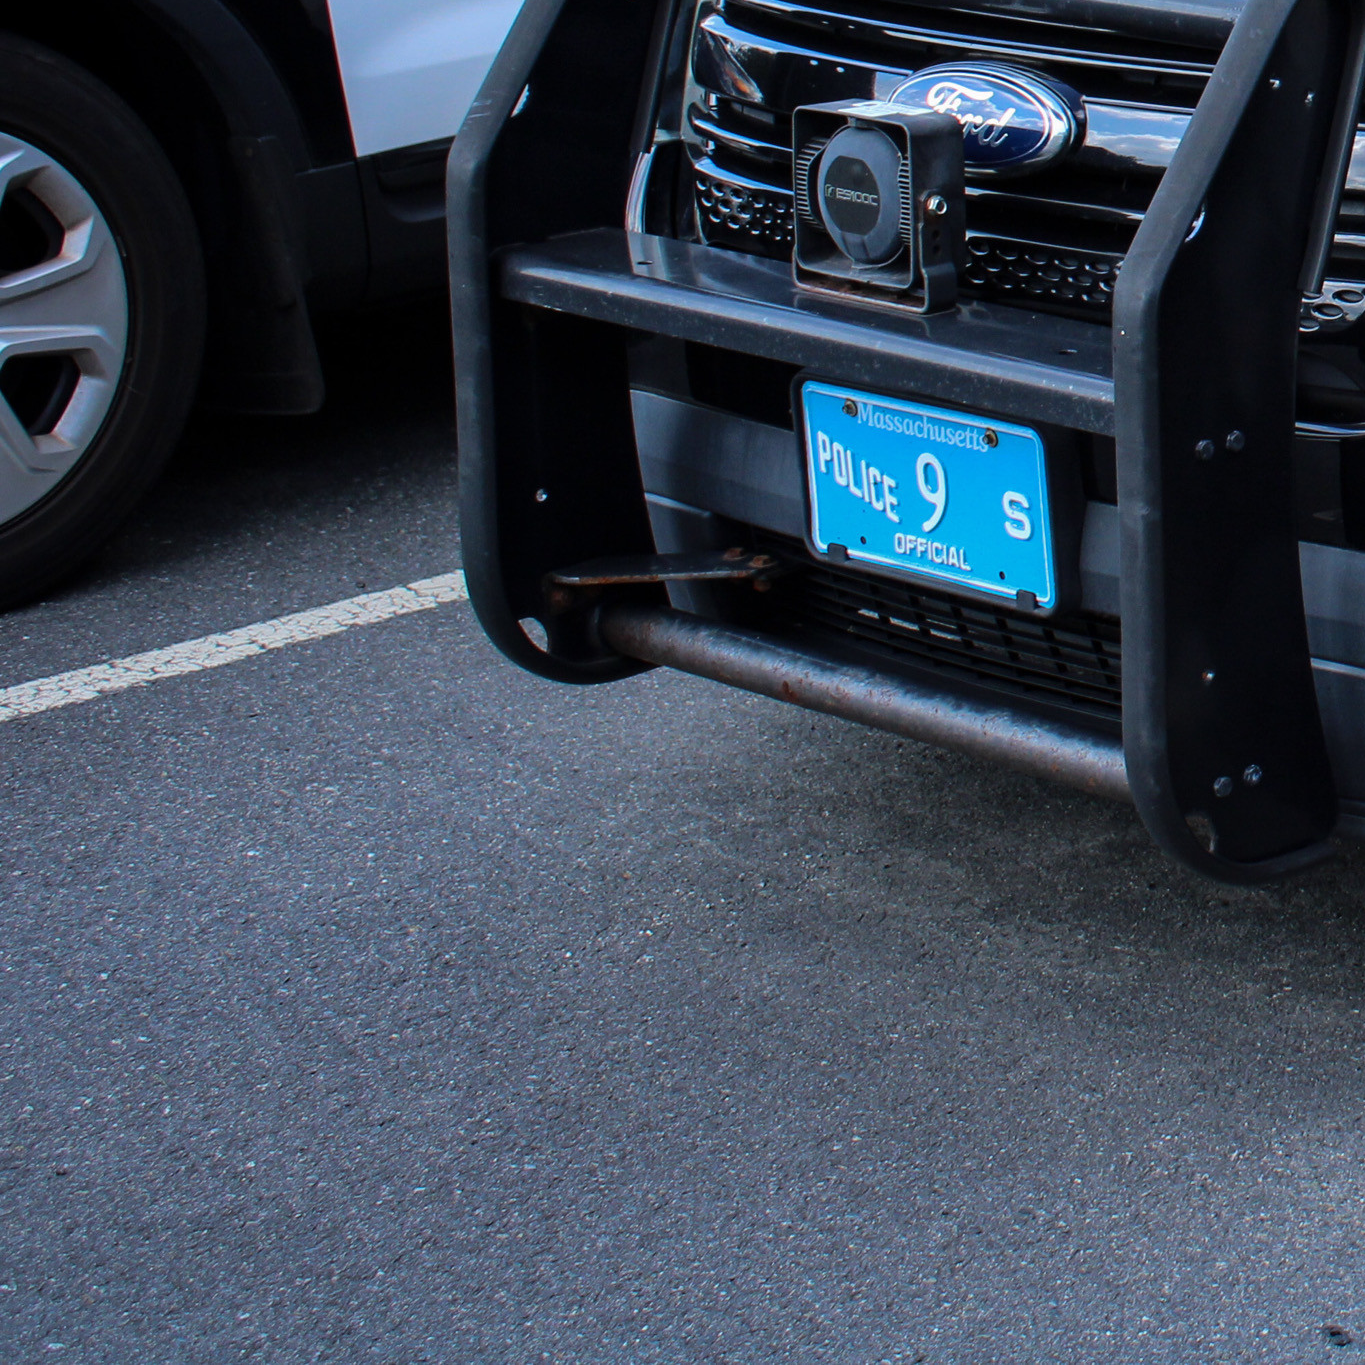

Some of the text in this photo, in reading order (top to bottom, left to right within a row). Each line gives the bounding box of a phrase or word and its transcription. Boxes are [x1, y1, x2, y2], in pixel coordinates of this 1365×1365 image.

[836, 187, 879, 206] ES100C
[856, 402, 990, 453] Massachusetts
[816, 430, 1032, 541] POLICE 9 S
[894, 532, 972, 572] OFFICIAL
